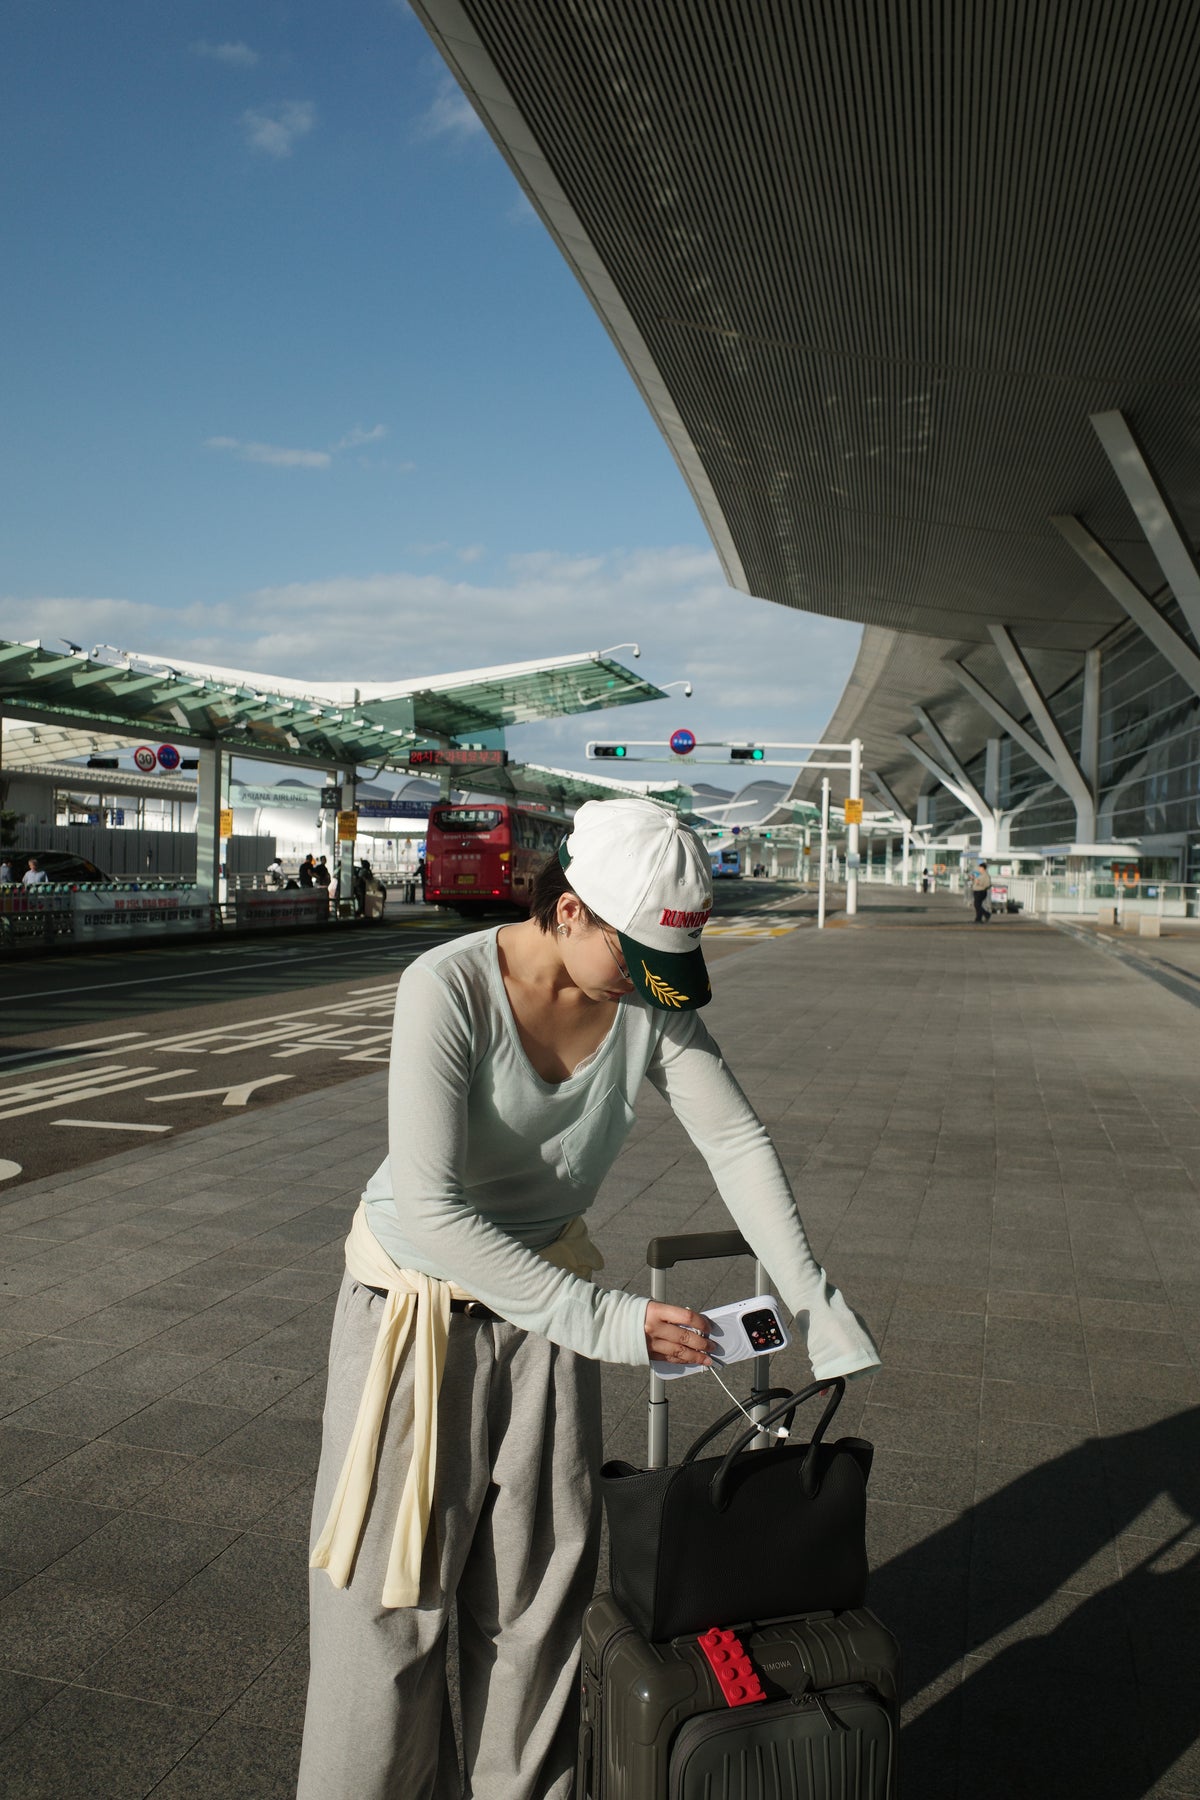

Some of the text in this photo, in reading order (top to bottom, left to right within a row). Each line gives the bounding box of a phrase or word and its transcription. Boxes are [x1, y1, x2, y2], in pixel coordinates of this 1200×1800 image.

[138, 753, 152, 765] 30
[242, 792, 309, 802] ASIANA AIRLINES
[1111, 863, 1141, 889] 10
[154, 1021, 393, 1063] 리무
